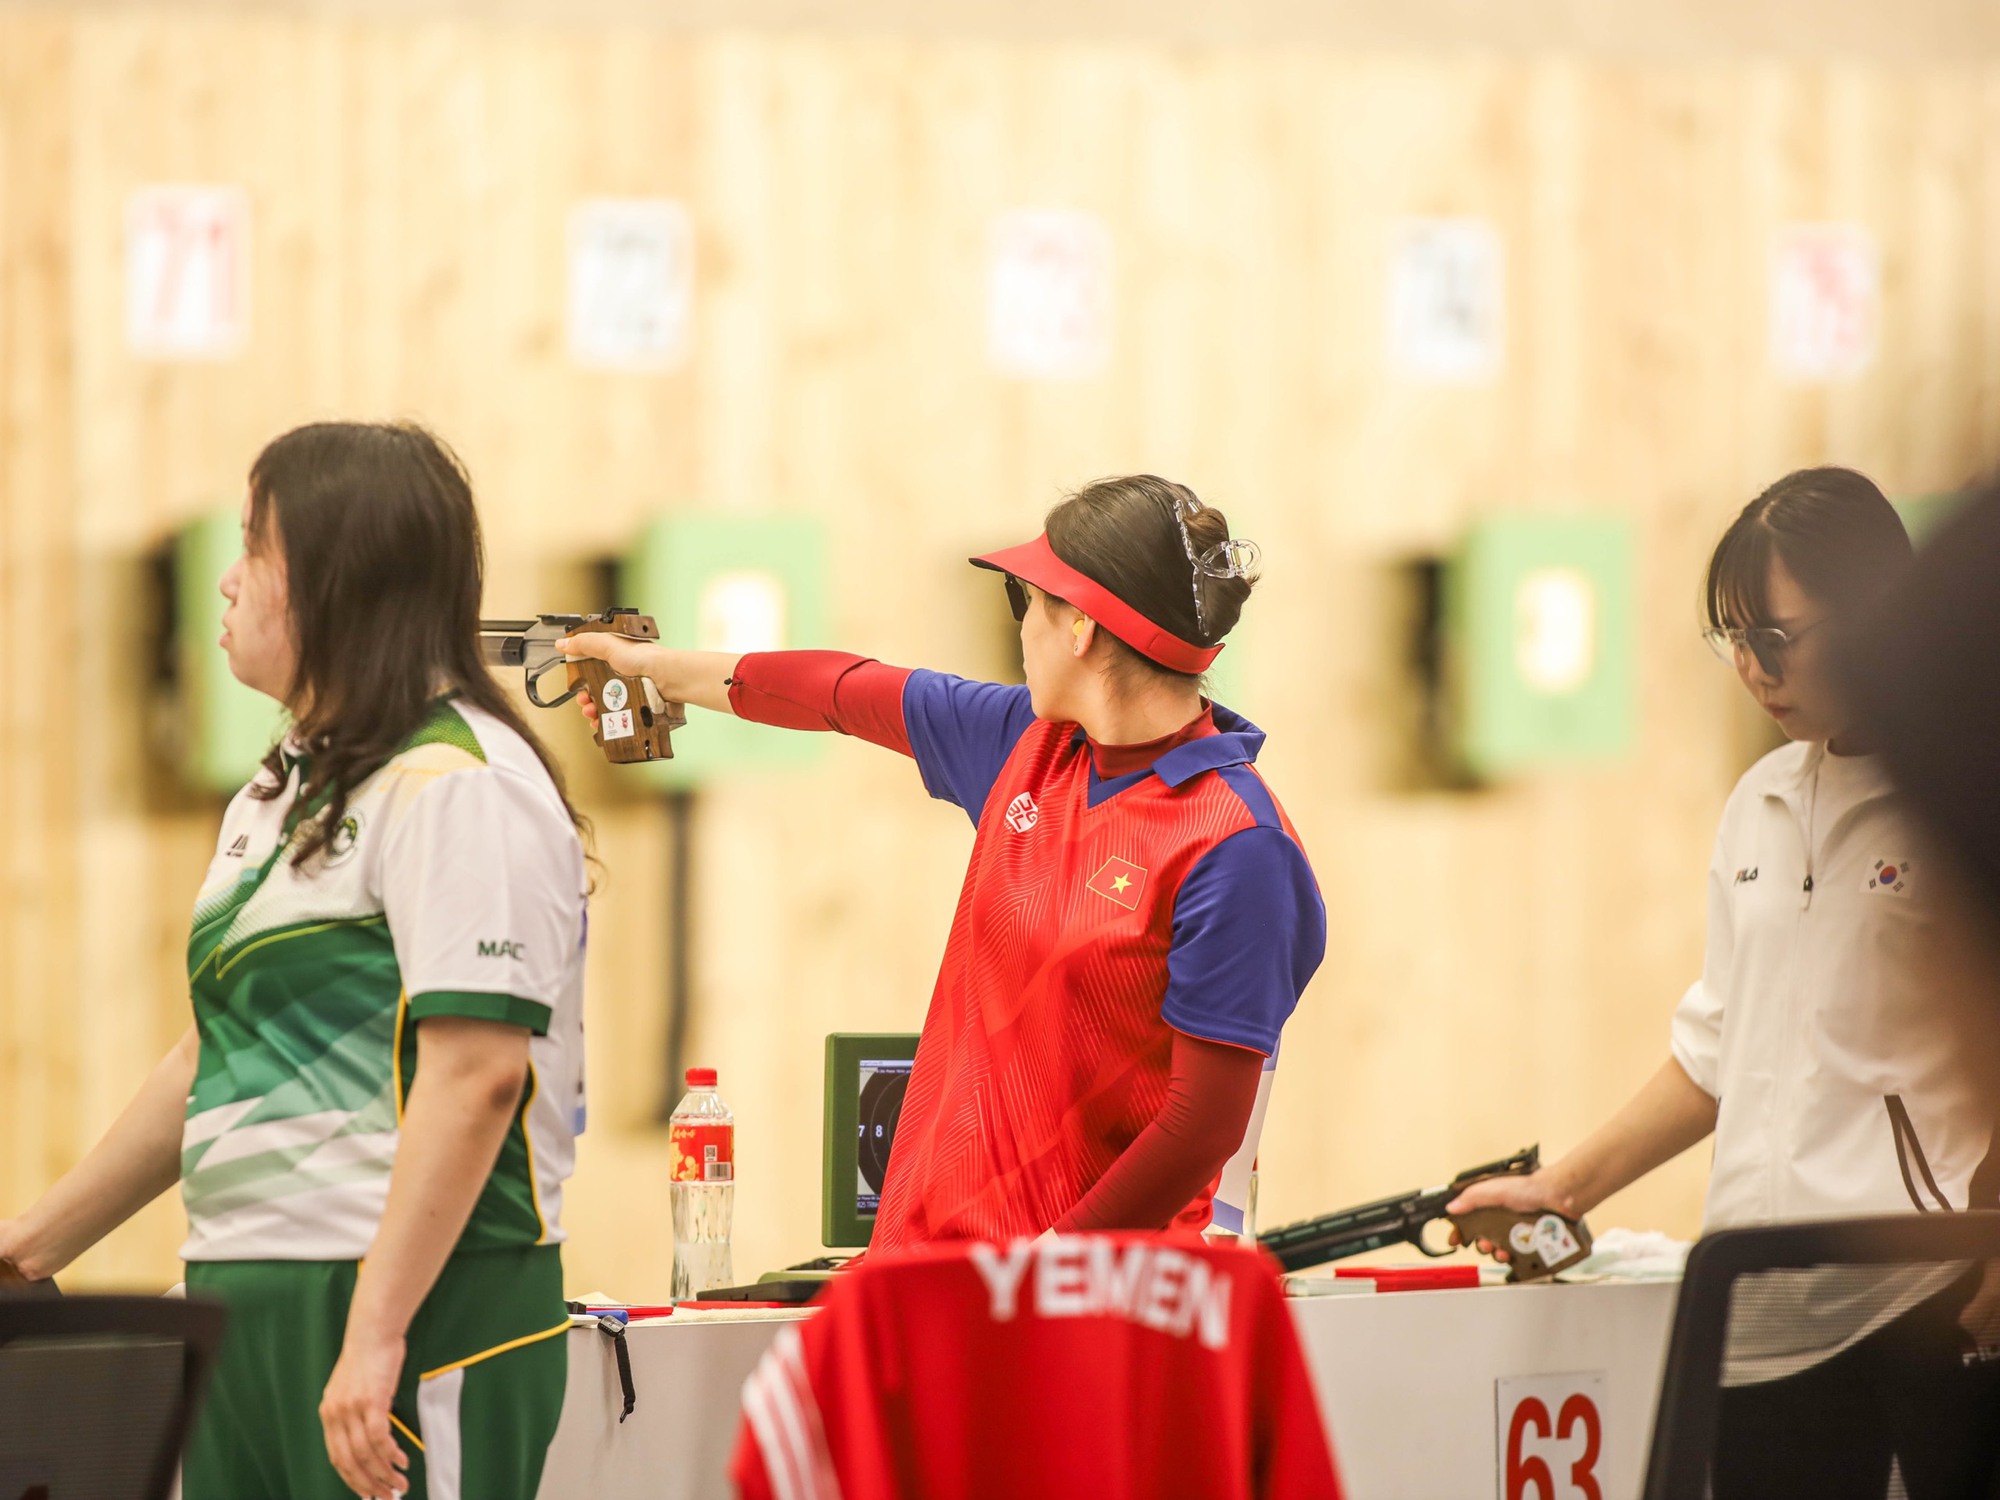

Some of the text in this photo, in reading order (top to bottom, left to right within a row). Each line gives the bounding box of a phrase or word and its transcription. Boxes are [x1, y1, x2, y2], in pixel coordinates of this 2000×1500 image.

[477, 939, 526, 963] MAC
[858, 1124, 883, 1138] 7 8
[968, 1235, 1233, 1350] YEMEN
[1505, 1392, 1603, 1500] 63
